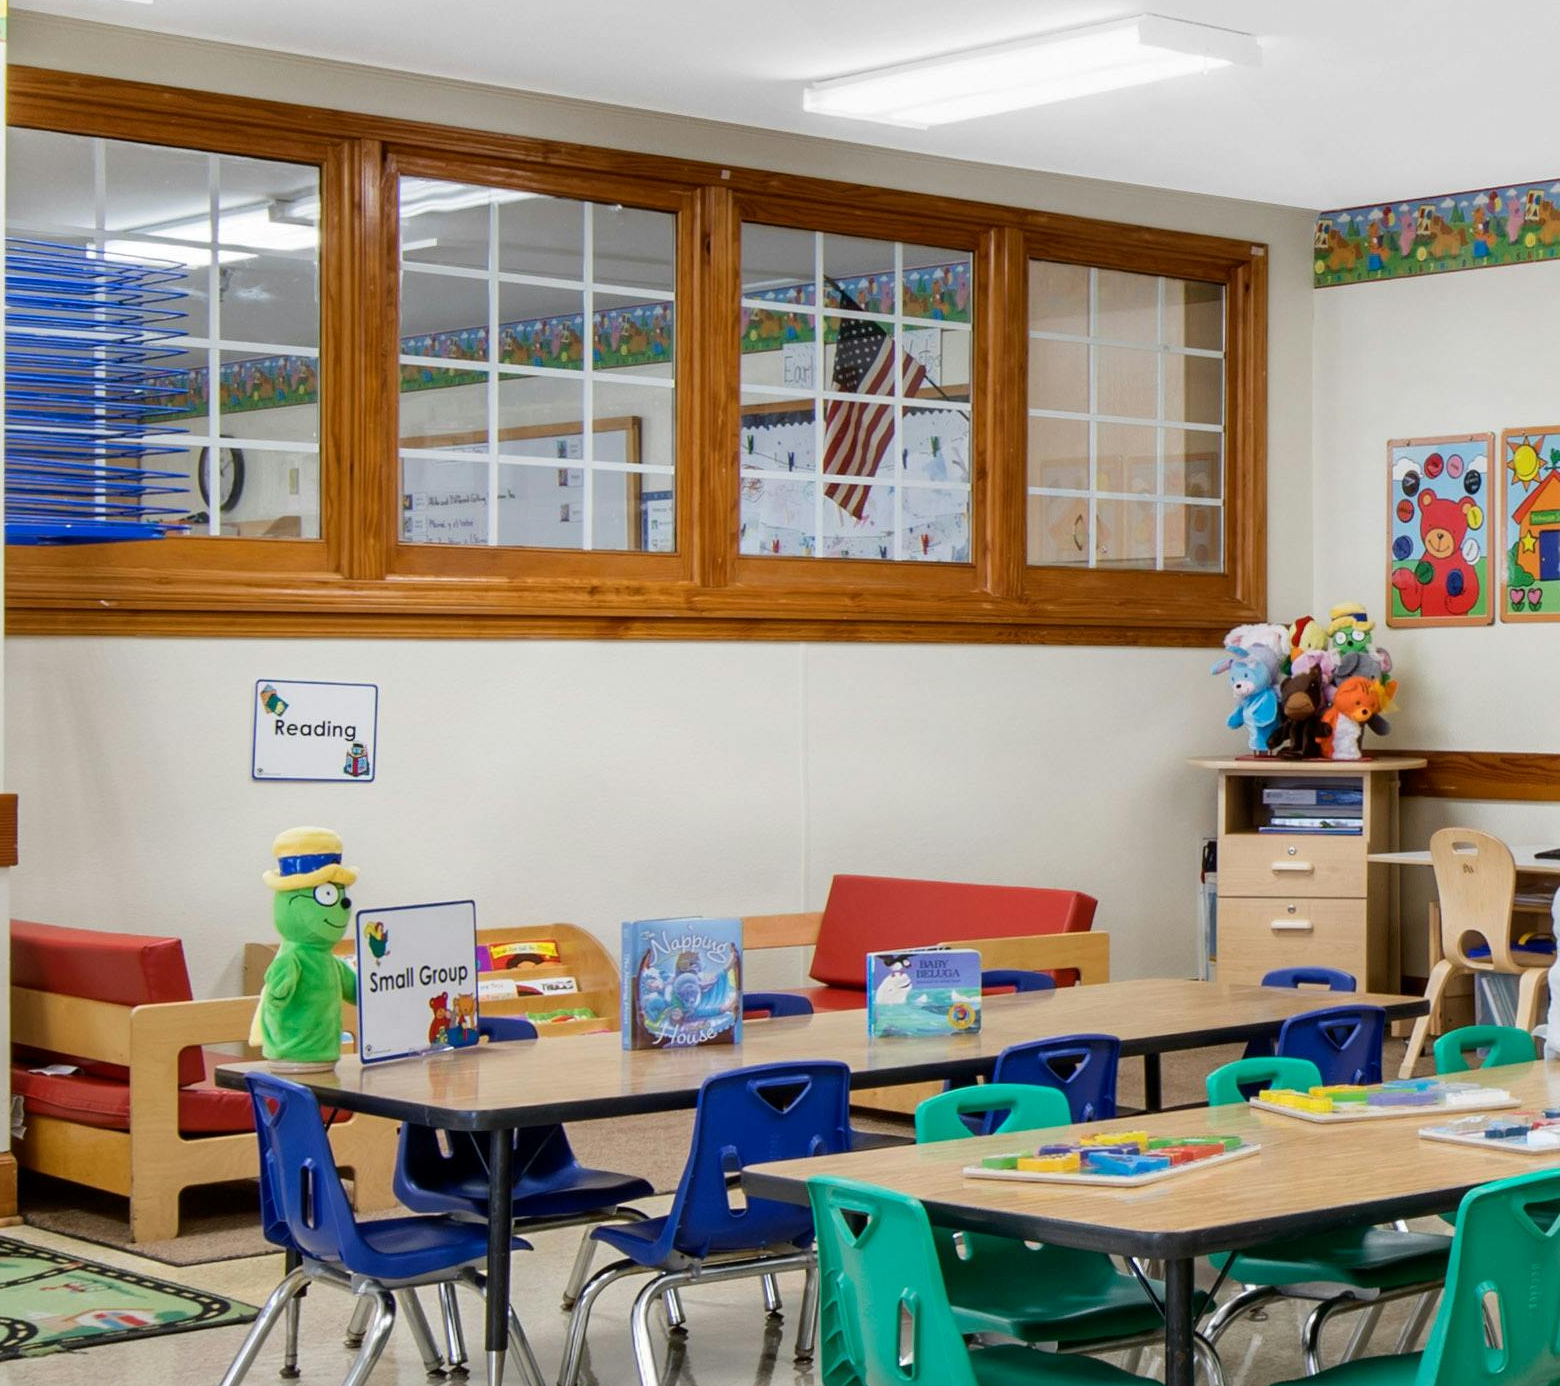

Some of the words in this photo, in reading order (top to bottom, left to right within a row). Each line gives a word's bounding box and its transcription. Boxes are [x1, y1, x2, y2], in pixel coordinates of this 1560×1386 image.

[784, 355, 814, 384] Earl
[274, 719, 357, 742] Reading
[648, 931, 730, 967] Napping
[916, 969, 960, 979] BELUGA
[920, 959, 949, 969] BABY
[369, 967, 414, 993] Small
[419, 965, 468, 986] Group
[652, 1021, 718, 1045] House
